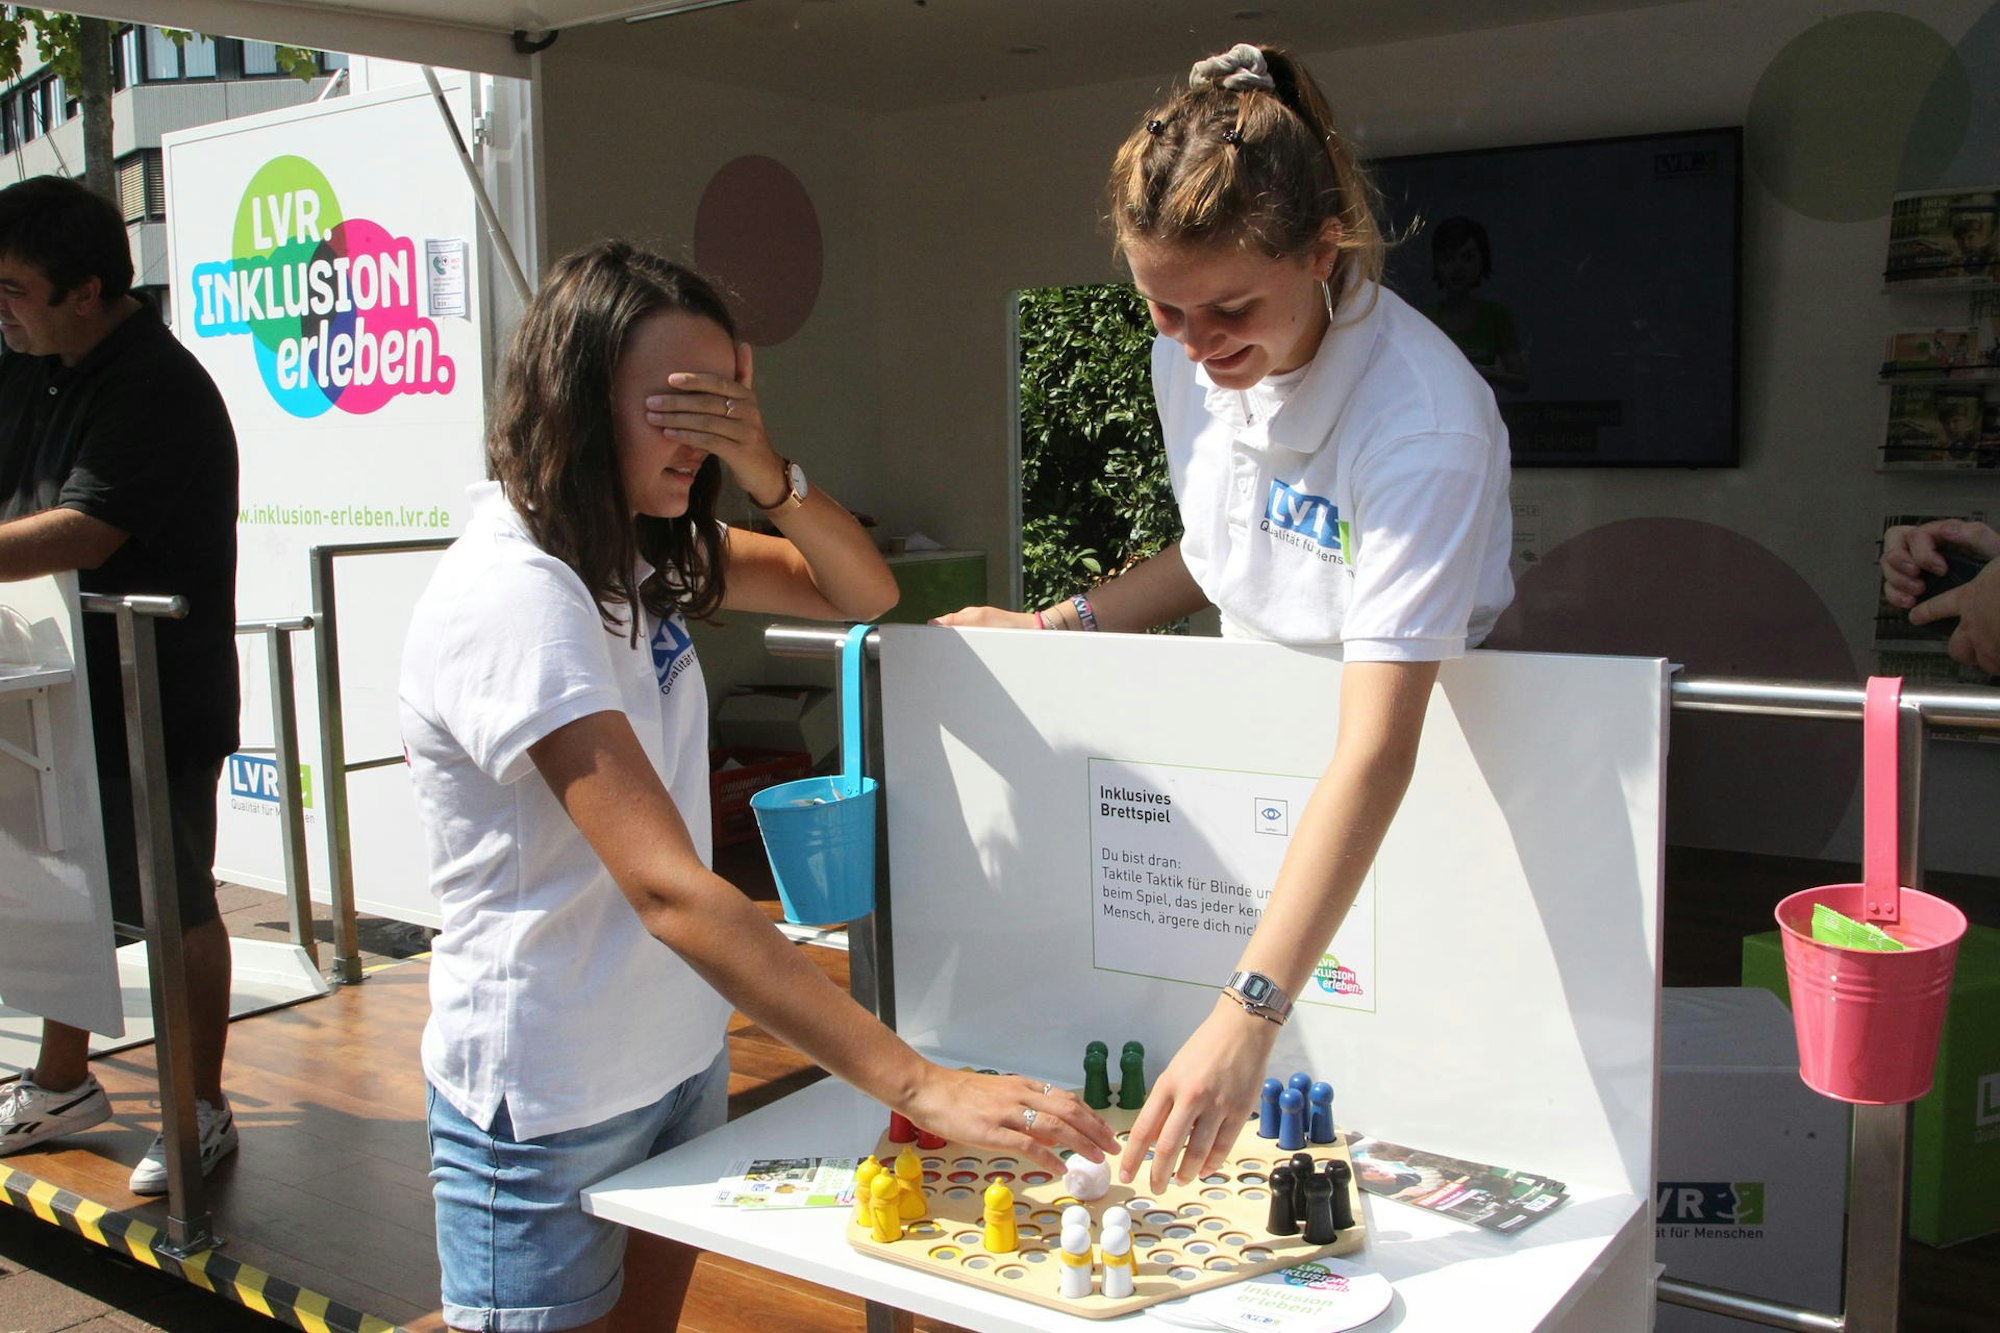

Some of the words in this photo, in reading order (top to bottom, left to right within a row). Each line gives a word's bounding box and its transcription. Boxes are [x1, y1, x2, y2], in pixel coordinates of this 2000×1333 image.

[252, 189, 332, 250] LVR.
[198, 250, 410, 326] INKLUSION
[276, 317, 449, 390] erleben.
[239, 504, 450, 528] w.inklusion-erleben.lvr.de
[1260, 519, 1300, 547] Qualität
[1302, 538, 1315, 553] fü
[232, 759, 280, 797] LVR
[1100, 785, 1171, 805] Inklusives
[1101, 803, 1171, 824] Brettspiel
[1102, 848, 1118, 862] Du
[1122, 851, 1144, 865] bist
[1149, 854, 1182, 869] dran:
[1102, 866, 1142, 883] Taktile
[1147, 872, 1184, 889] Taktik
[1188, 877, 1206, 891] für
[1211, 880, 1252, 896] Blinde
[1256, 888, 1272, 899] un
[1103, 886, 1133, 900] beim
[1136, 890, 1171, 908] Spiel,
[1175, 895, 1198, 909] das
[1200, 899, 1235, 914] jeder
[1239, 903, 1263, 918] ken
[1103, 904, 1154, 925] Mensch,
[1158, 911, 1200, 929] ärgere
[1203, 919, 1230, 933] dich
[1323, 979, 1364, 995] erleben.
[1656, 1188, 1705, 1219] VR
[1670, 1227, 1690, 1239] für
[1694, 1227, 1764, 1239] Menschen
[1236, 1294, 1323, 1316] erleben!
[1242, 1284, 1334, 1308] Inklusion
